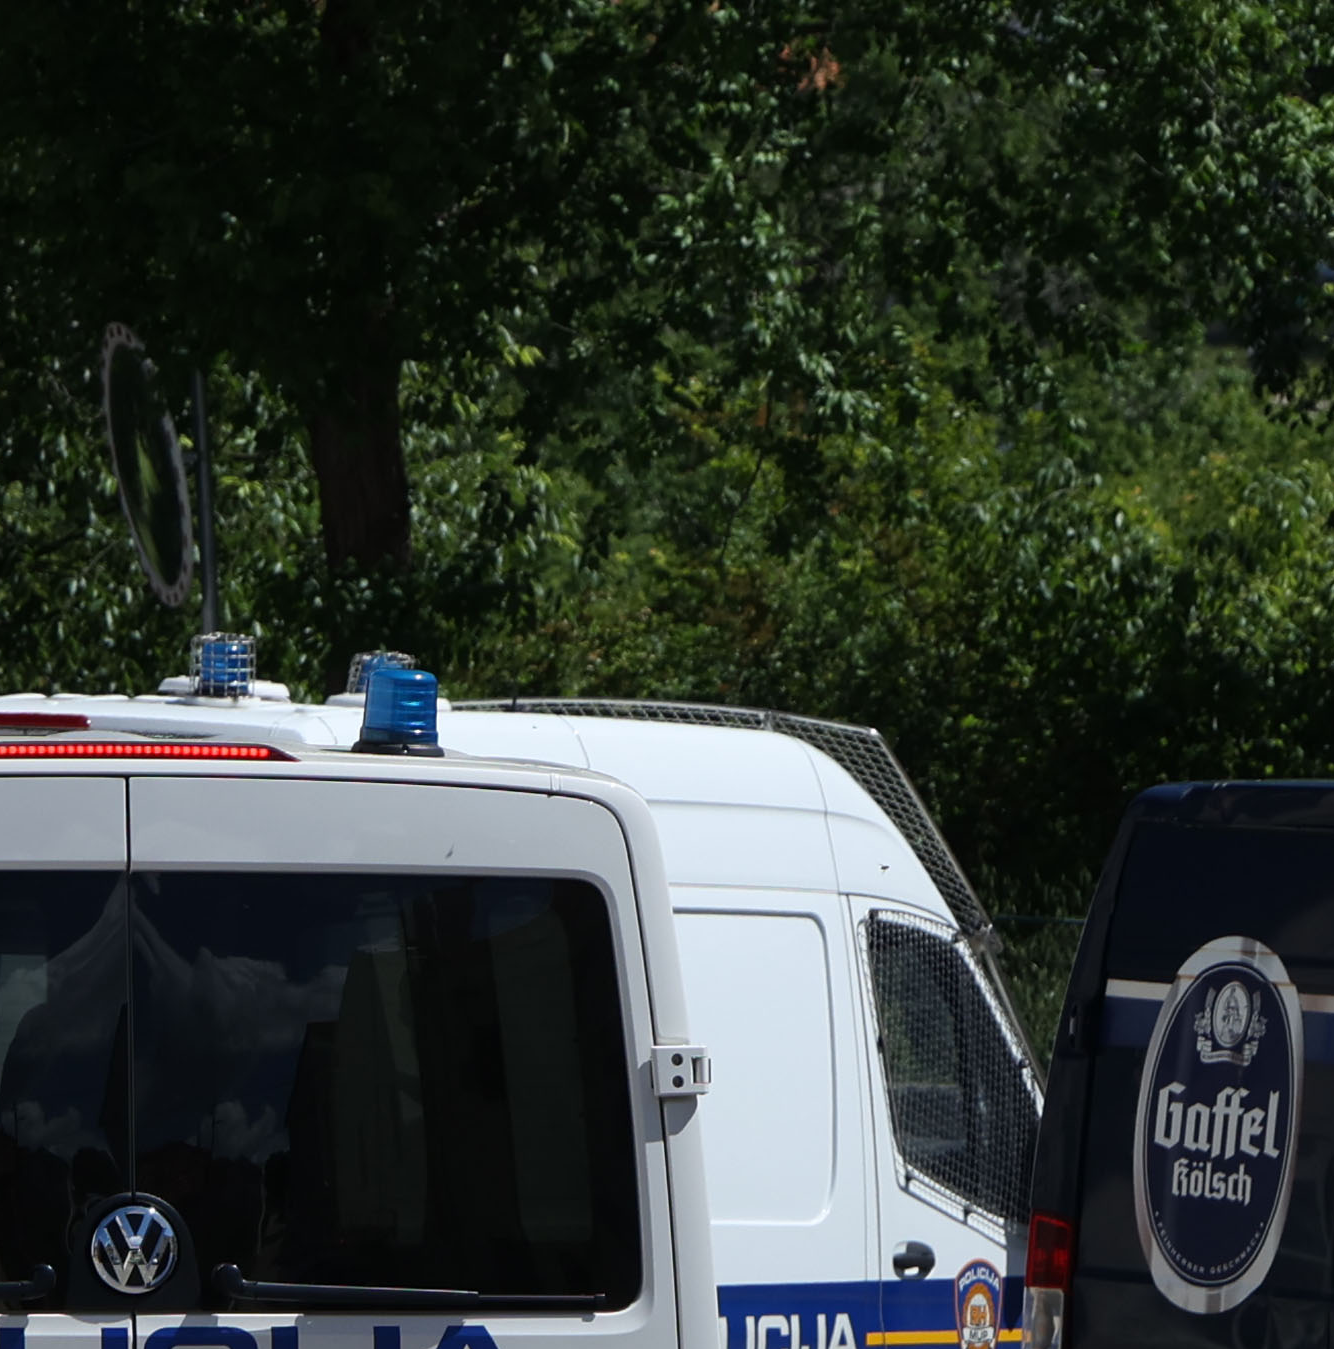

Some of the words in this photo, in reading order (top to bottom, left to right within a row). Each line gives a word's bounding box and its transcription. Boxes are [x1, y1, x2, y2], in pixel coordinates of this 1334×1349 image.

[1154, 1081, 1280, 1160] Gaffel
[1171, 1158, 1252, 1207] Kölsch
[959, 1267, 1000, 1292] POLICIJA
